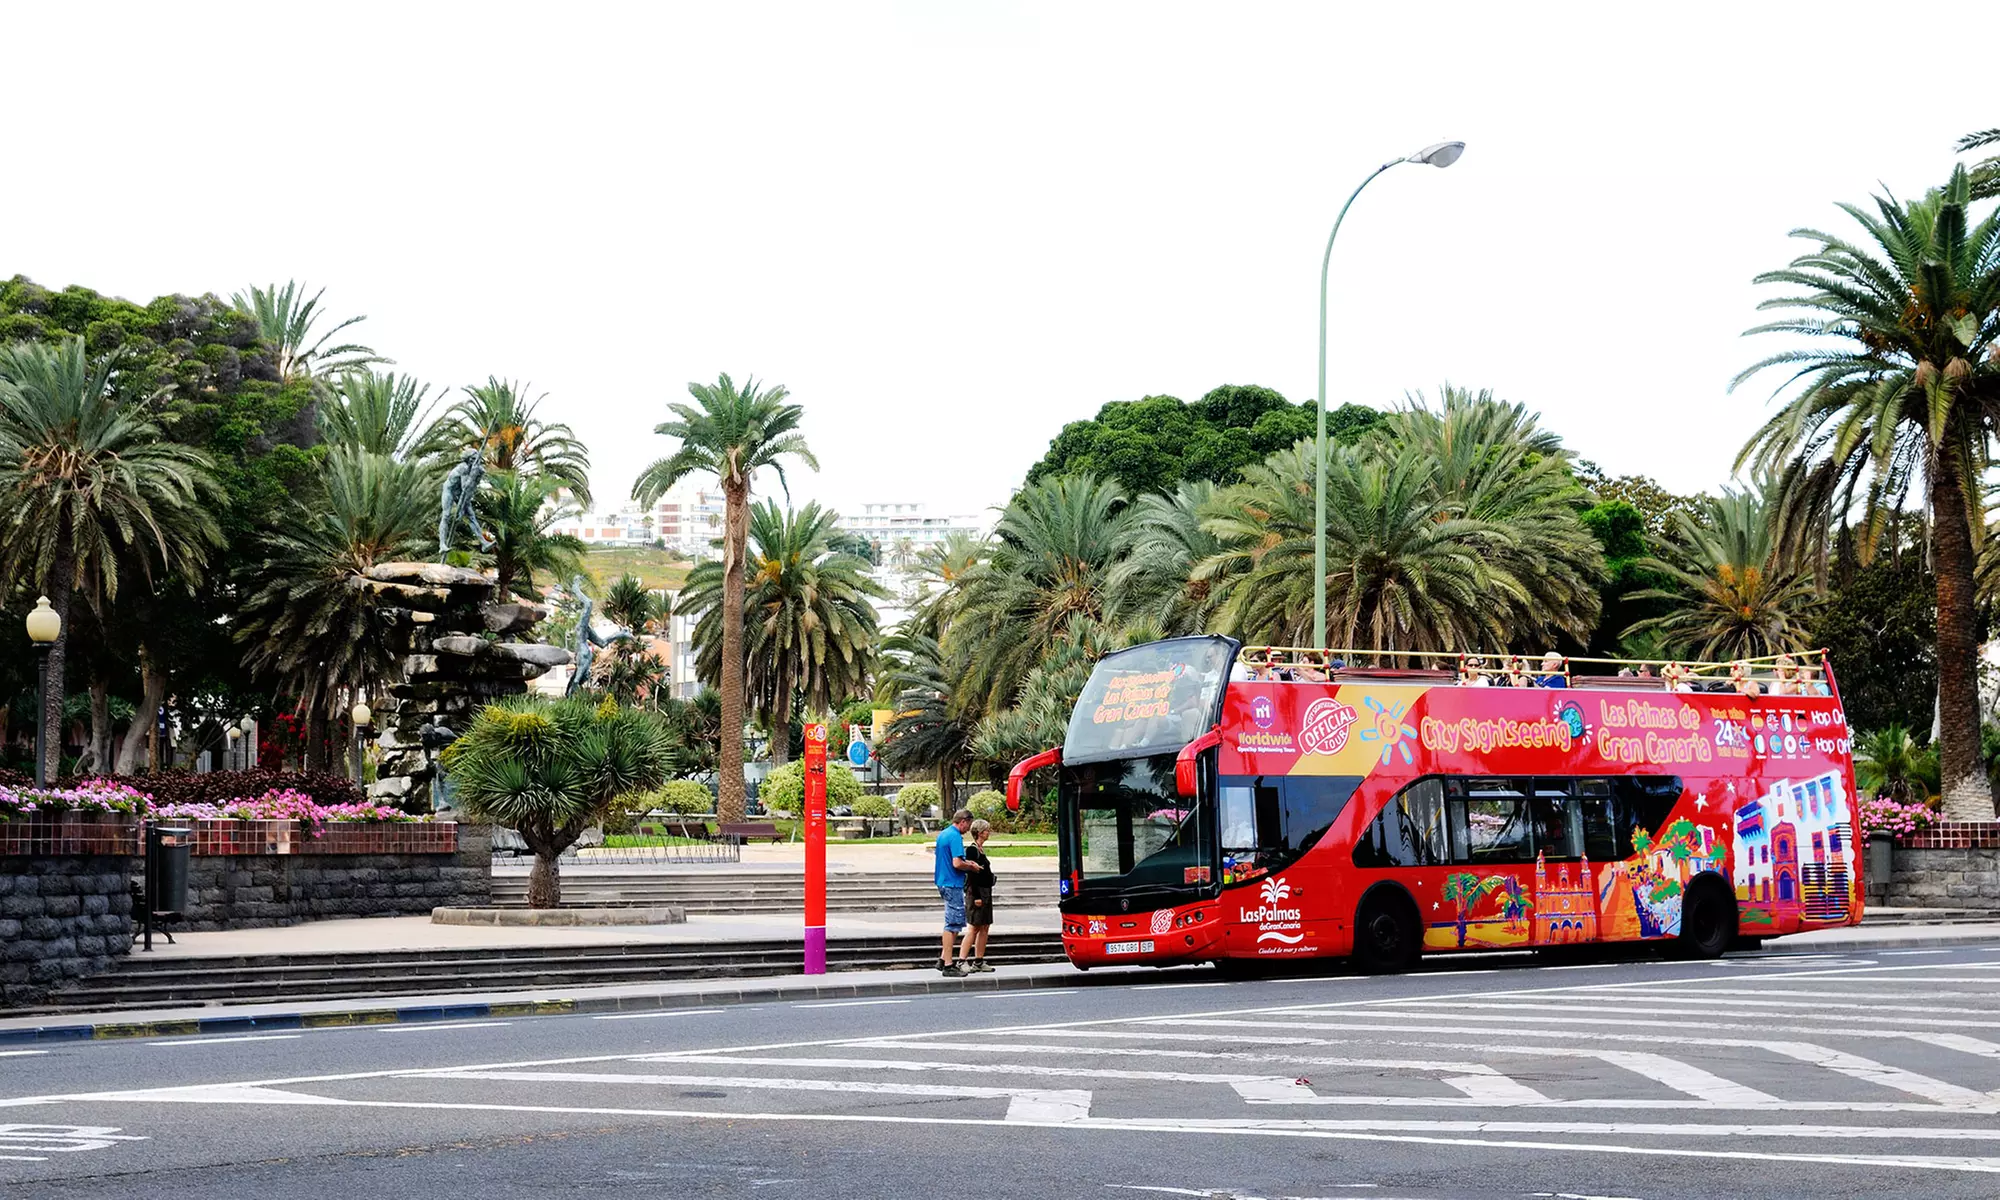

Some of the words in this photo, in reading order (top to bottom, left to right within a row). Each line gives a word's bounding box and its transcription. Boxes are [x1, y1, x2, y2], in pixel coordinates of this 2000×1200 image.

[1093, 705, 1123, 724] Gran
[1124, 699, 1170, 721] Canaria
[1600, 698, 1628, 728] Las
[1627, 698, 1678, 730] Palmas
[1679, 702, 1701, 730] de
[1810, 710, 1831, 727] Hop
[1832, 708, 1847, 725] On
[1238, 731, 1293, 746] Worldwide
[1304, 708, 1355, 747] OFFICIAL
[1420, 715, 1460, 754] City
[1460, 716, 1572, 754] Sightseeing
[1324, 729, 1347, 750] TOUR
[1597, 727, 1644, 763] Gran
[1645, 731, 1712, 764] Canaria
[1815, 737, 1835, 755] Hop
[1240, 904, 1301, 922] LasPalmas
